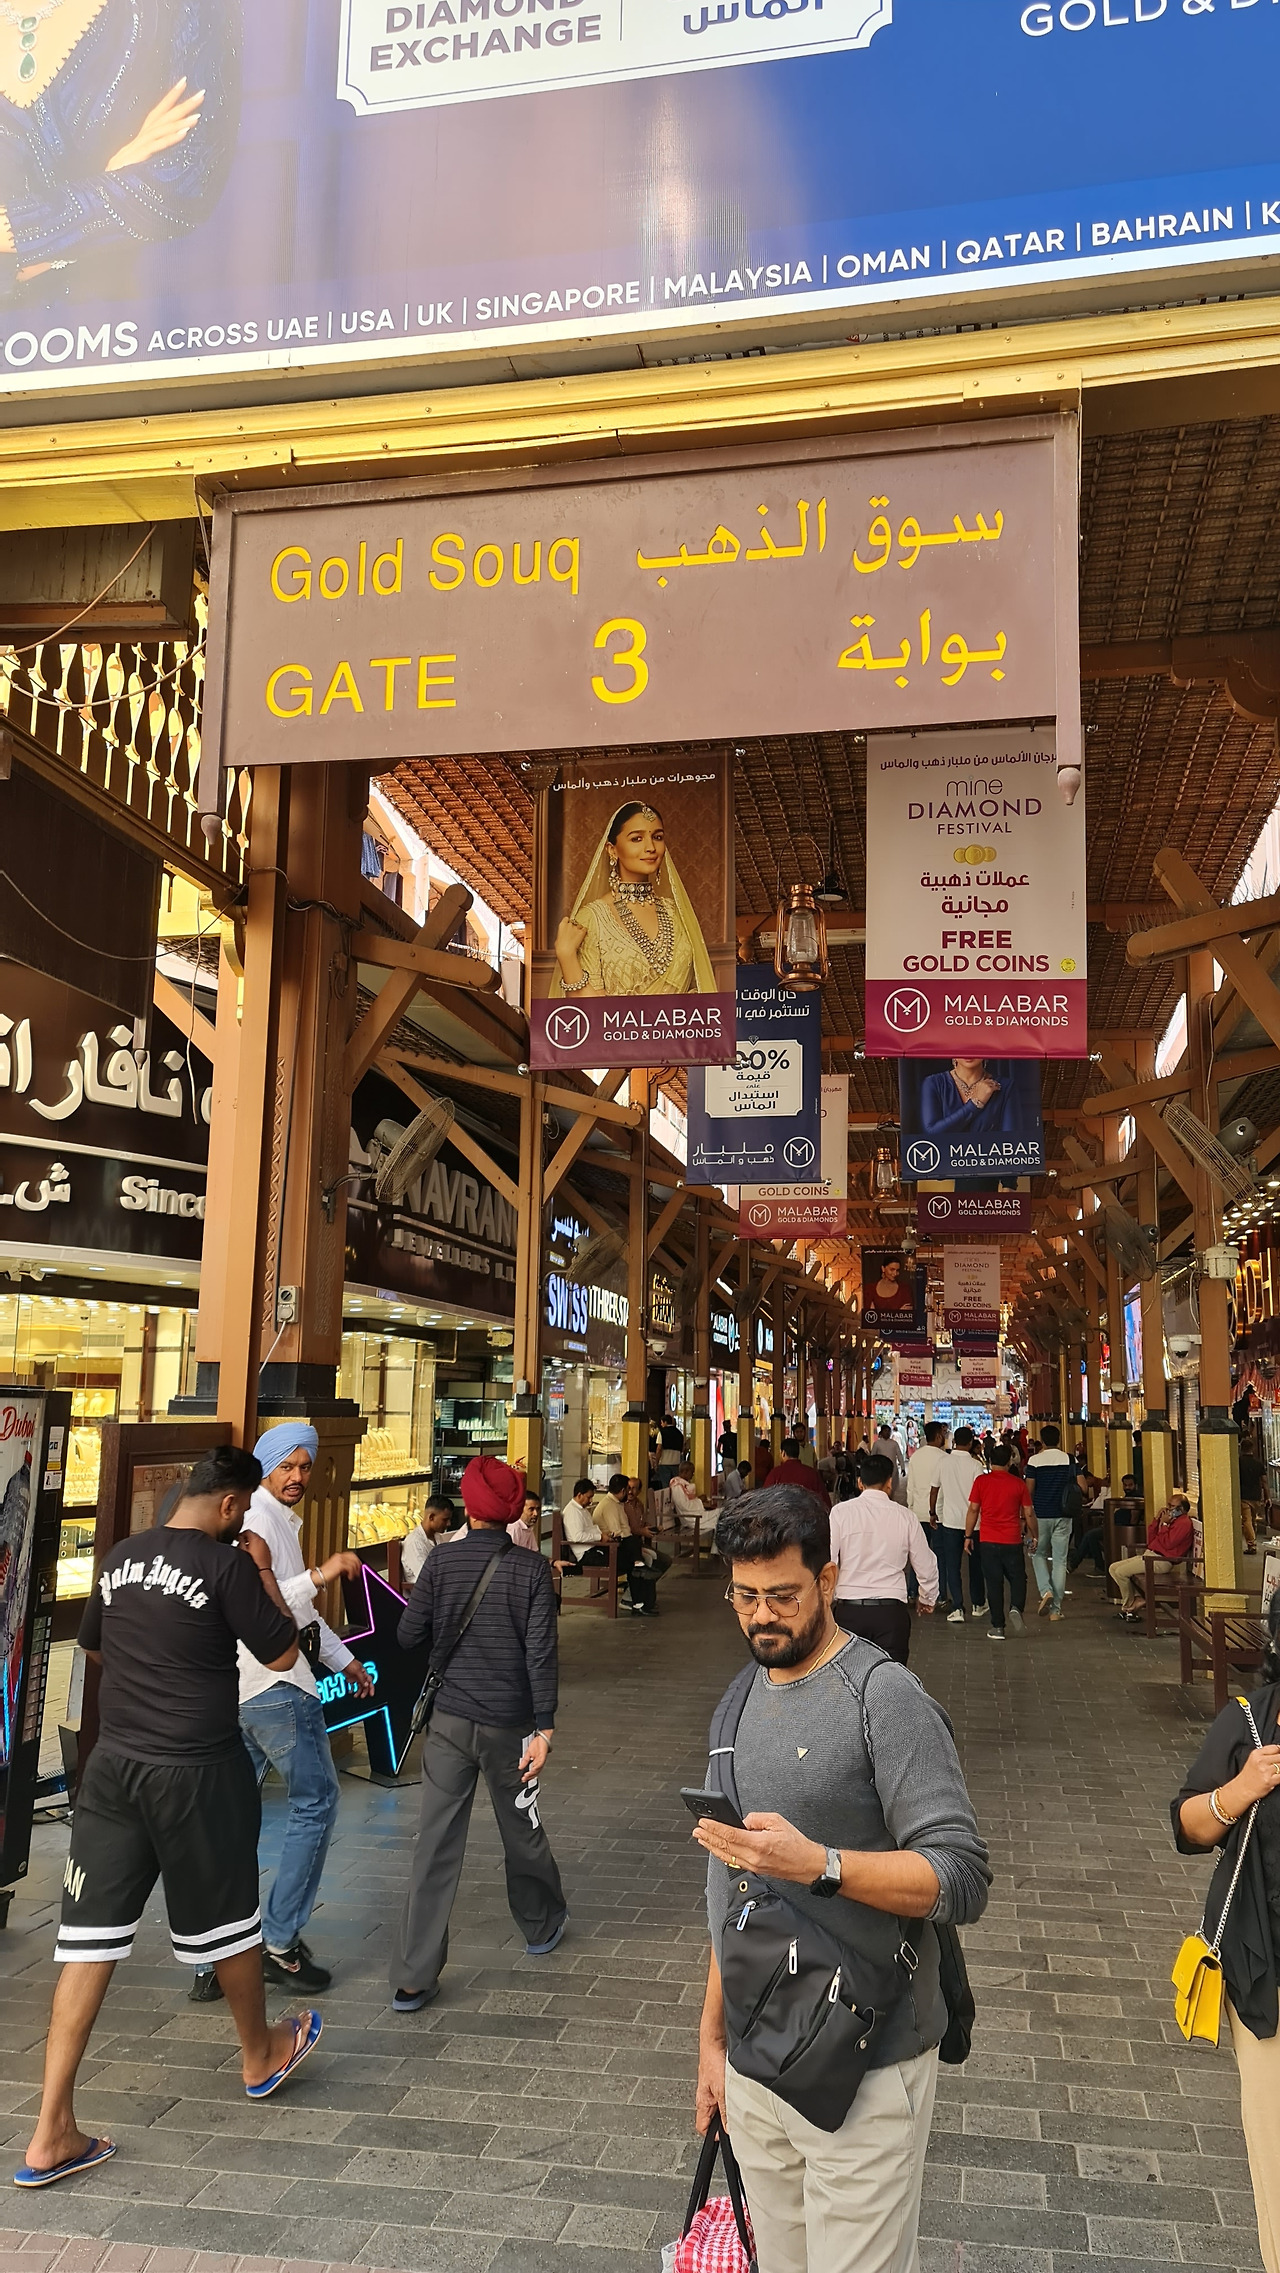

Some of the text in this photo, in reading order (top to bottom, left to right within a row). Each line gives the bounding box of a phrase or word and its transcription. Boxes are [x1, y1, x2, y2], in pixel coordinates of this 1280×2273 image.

[1020, 0, 1167, 37] GOLD
[370, 15, 601, 72] EXCHANGE
[0, 201, 1280, 367] OOMS ACROSS UAE USA UK SINGAPORE MALAYSIA OMAN QATAR BAHRAIN K
[636, 495, 1004, 588] سوق الذهب
[270, 532, 580, 603] Gold Souq
[837, 608, 1008, 689] بوابة
[265, 617, 649, 718] GATE 3
[922, 757, 945, 769] ذهب
[974, 754, 989, 766] من
[593, 777, 619, 789] ذهب
[650, 775, 665, 786] من
[667, 772, 716, 784] مجوهرات
[946, 775, 1003, 796] mine
[908, 798, 1042, 820] DIAMOND
[938, 822, 1012, 835] FESTIVAL
[920, 870, 1030, 892] عملات ذهبية
[941, 895, 1009, 919] مجانية
[942, 930, 1012, 949] FREE
[903, 955, 1050, 973] GOLD COINS
[741, 988, 775, 1003] الوقت
[768, 1004, 810, 1020] تستثمر
[944, 995, 1069, 1013] MALABAR
[603, 1008, 722, 1028] MALABAR
[744, 1006, 766, 1021] في
[945, 1016, 1069, 1026] GOLD & DIAMONDS
[603, 1028, 722, 1041] GOLD & DIAMONDS
[736, 1071, 771, 1083] قيمة
[728, 1090, 779, 1102] استبدال
[734, 1100, 776, 1112] الماس
[950, 1141, 1040, 1157] MALABAR
[950, 1157, 1041, 1167] GOLD & DIAMONDS
[758, 1186, 829, 1197] GOLD COINS
[392, 1158, 518, 1251] NAVRAN
[777, 1206, 838, 1216] MALABAR
[958, 1199, 1021, 1209] MALABAR
[391, 1228, 490, 1275] JEWELLERS
[98, 1555, 210, 1609] Palm Angels
